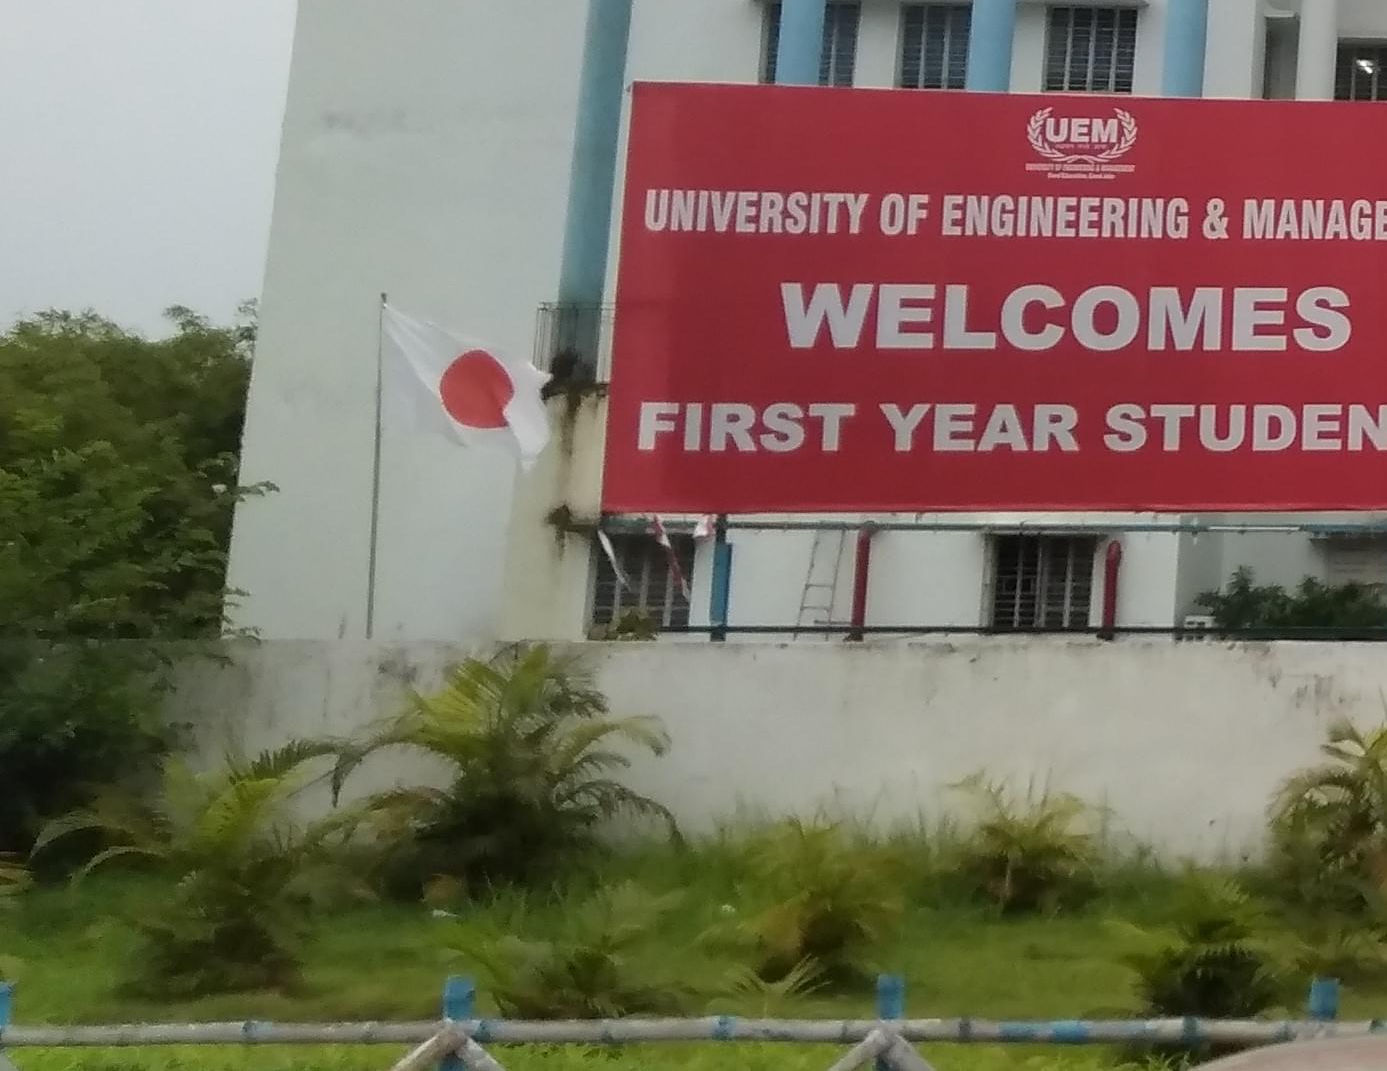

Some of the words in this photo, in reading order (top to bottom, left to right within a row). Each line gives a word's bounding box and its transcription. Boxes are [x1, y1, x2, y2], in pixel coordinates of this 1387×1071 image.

[1045, 117, 1119, 143] UEM
[644, 189, 869, 234] UNIVERSITY
[880, 194, 929, 236] OF
[941, 195, 1189, 239] ENGINEERING
[1202, 198, 1229, 240] &
[780, 282, 1352, 352] WELCOMES
[637, 401, 856, 452] FIRST
[879, 403, 1080, 452] YEAR
